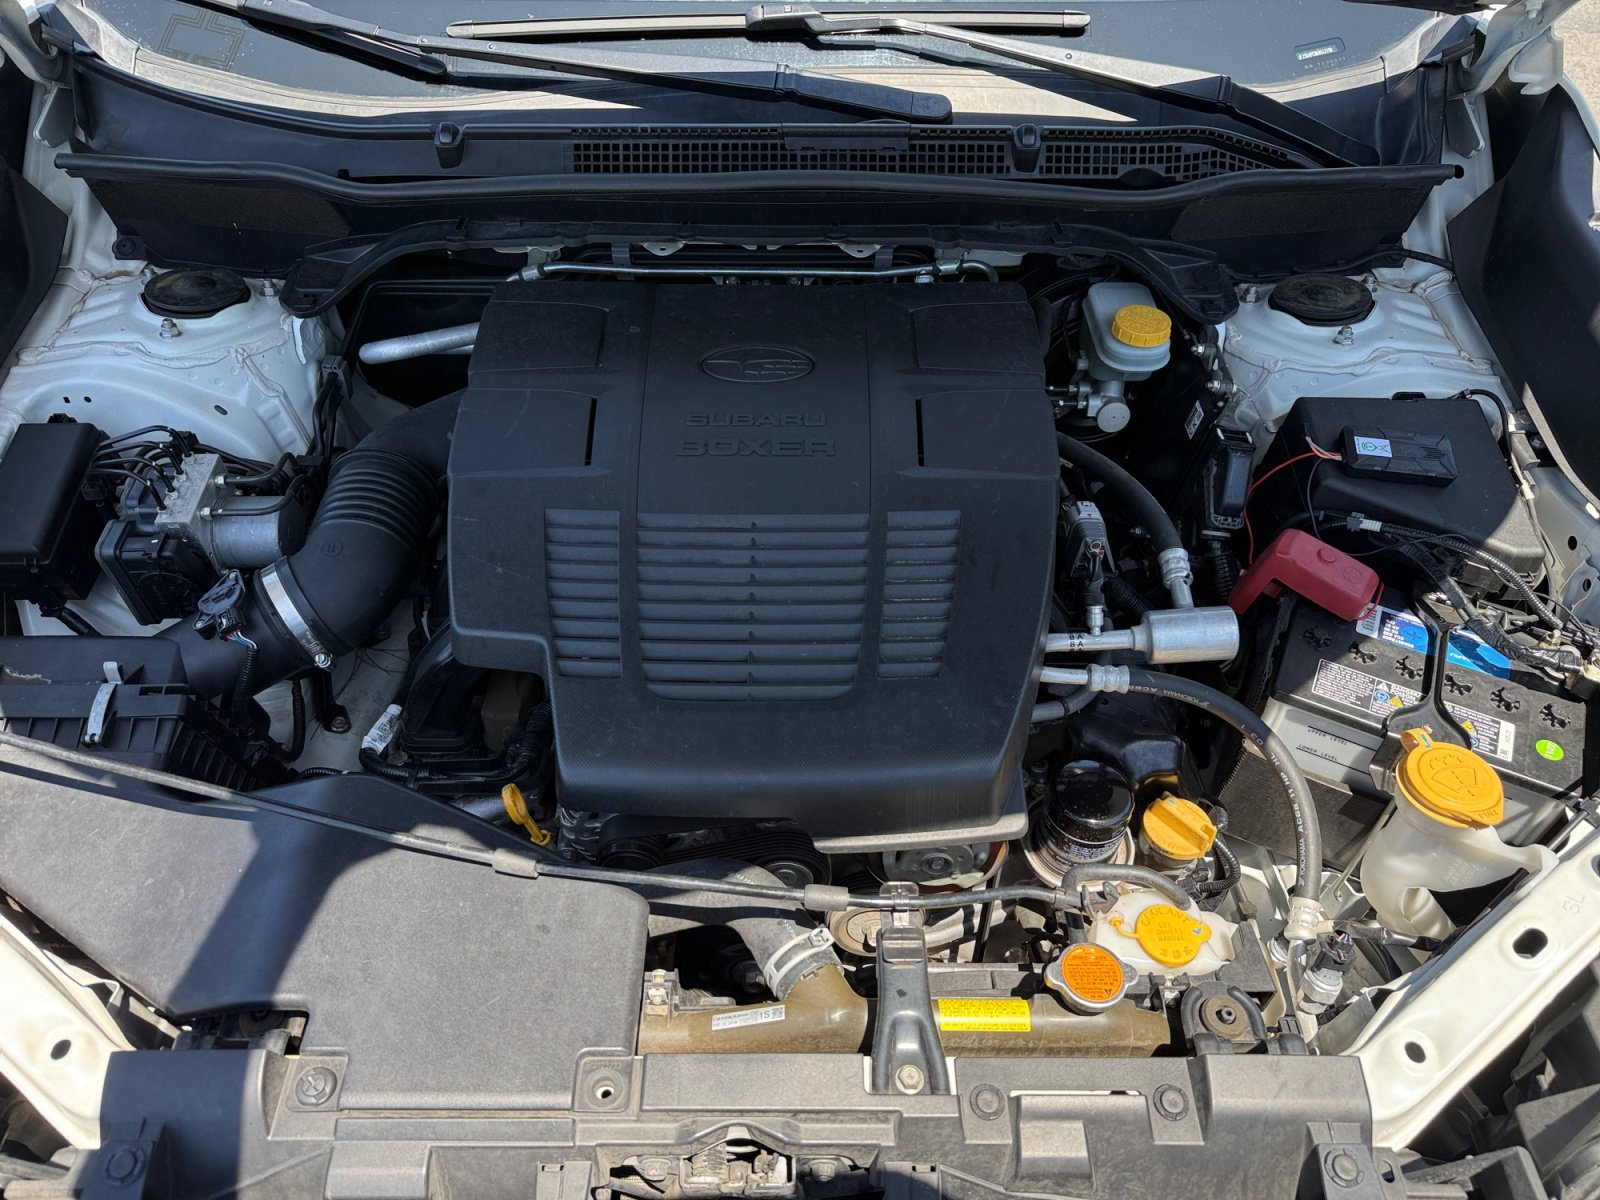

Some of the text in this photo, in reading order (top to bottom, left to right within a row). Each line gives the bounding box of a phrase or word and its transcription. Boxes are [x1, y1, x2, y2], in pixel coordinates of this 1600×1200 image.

[685, 412, 827, 428] SUBARU
[675, 437, 836, 457] BOXER
[1307, 728, 1348, 746] UPPER LEVEL
[1298, 743, 1338, 761] LOWER LEVEL
[1280, 772, 1291, 785] HP
[1140, 906, 1191, 927] COOLANT
